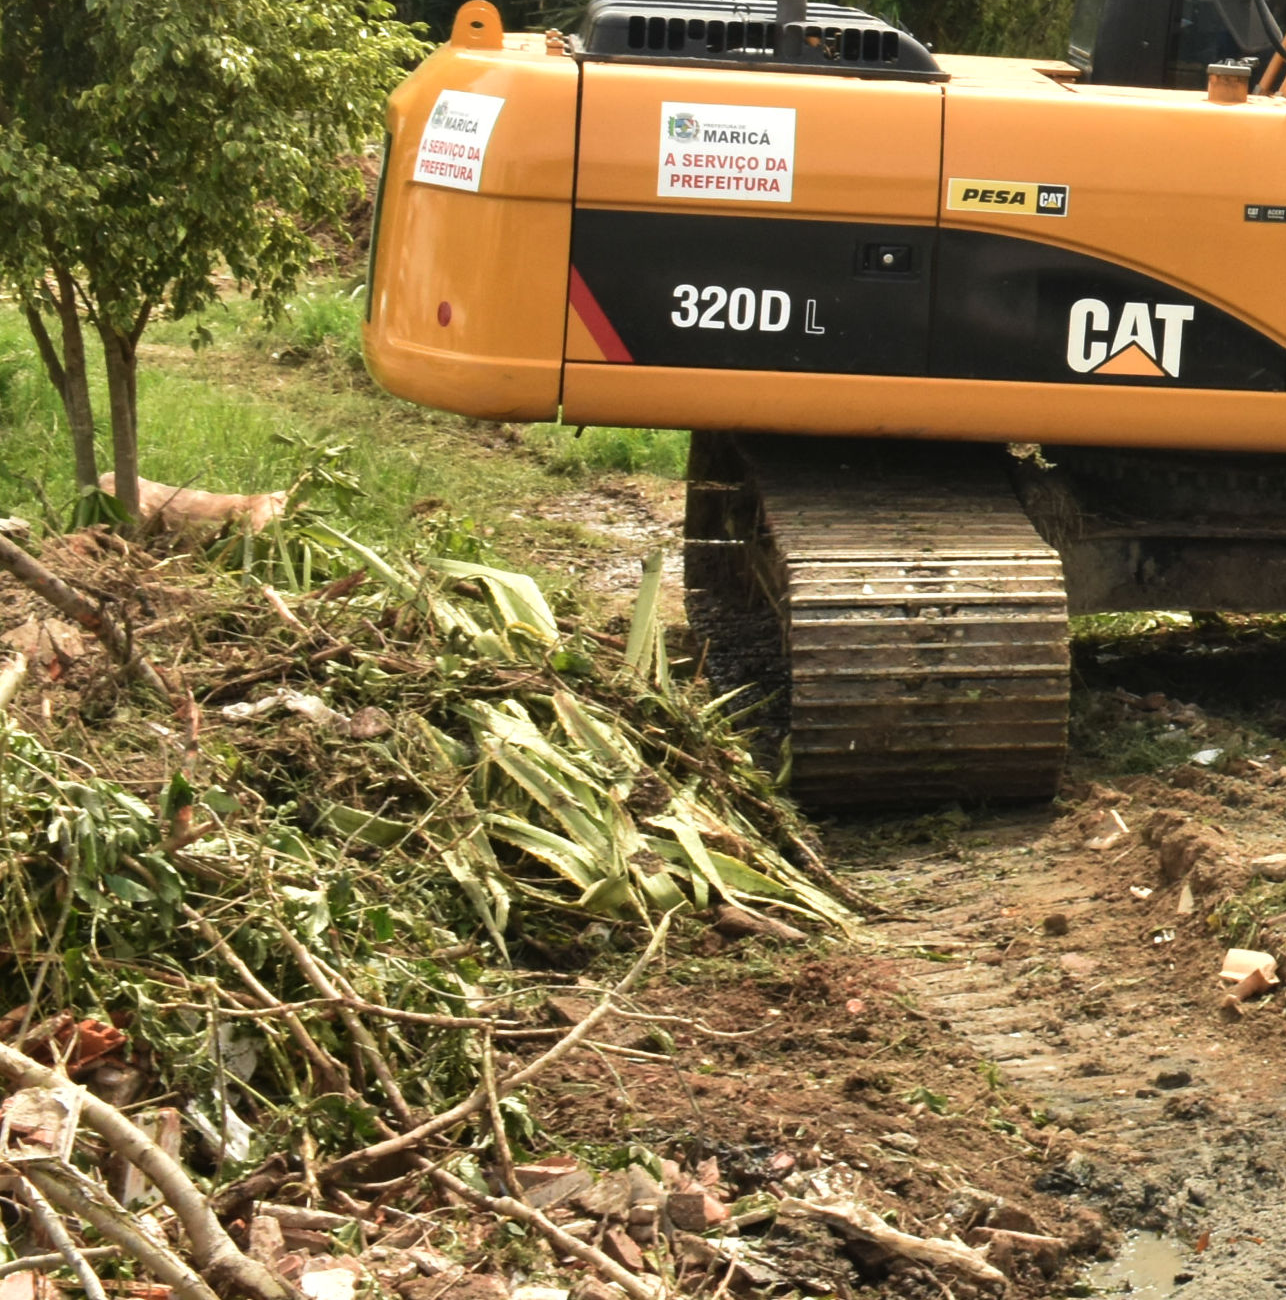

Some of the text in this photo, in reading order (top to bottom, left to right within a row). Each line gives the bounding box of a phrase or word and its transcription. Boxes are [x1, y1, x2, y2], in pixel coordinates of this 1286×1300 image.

[703, 129, 771, 145] MARICÁ
[422, 139, 481, 161] A SERVIÇO DA
[420, 159, 473, 181] PREFEITURA
[664, 152, 788, 173] A SERVIÇO DA
[670, 173, 780, 192] PREFEITURA
[962, 188, 1026, 205] PESA
[1039, 192, 1064, 207] CAT
[671, 284, 825, 334] 320D L
[1066, 298, 1195, 378] CAT
